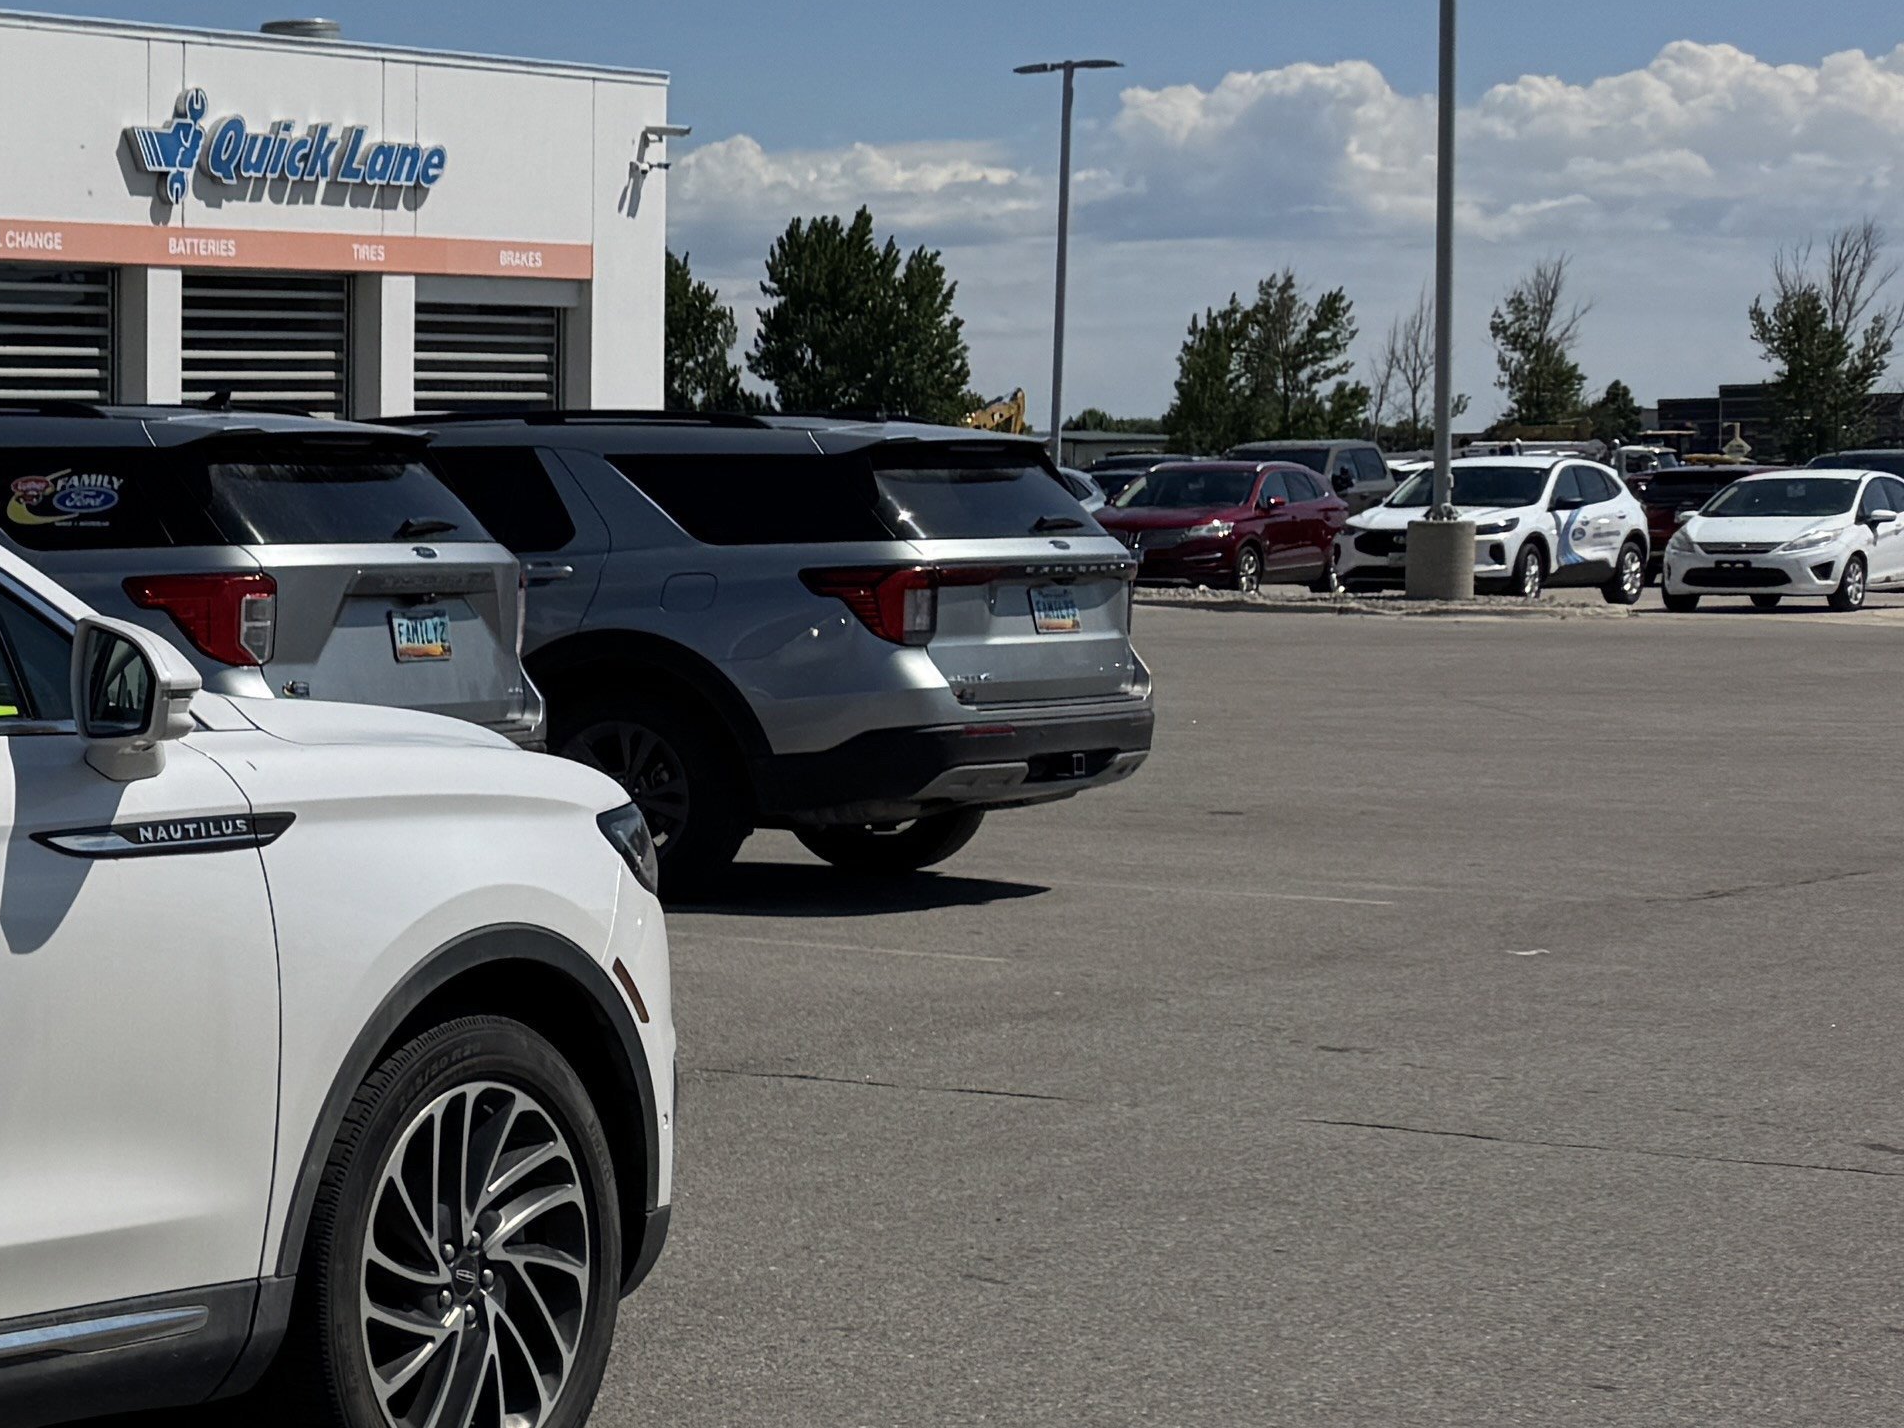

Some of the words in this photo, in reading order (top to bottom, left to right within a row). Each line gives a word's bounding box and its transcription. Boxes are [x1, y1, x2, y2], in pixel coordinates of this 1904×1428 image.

[208, 114, 340, 185] Quick
[338, 125, 448, 187] Lane
[6, 231, 63, 251] CHANGE
[168, 237, 236, 257] BATTERIES
[352, 243, 385, 262] TIRES
[499, 250, 543, 269] BRAKES
[56, 474, 124, 492] FAMILY
[65, 490, 105, 506] Ford
[398, 622, 449, 645] FAMILY2
[139, 820, 248, 842] NAUTILUS
